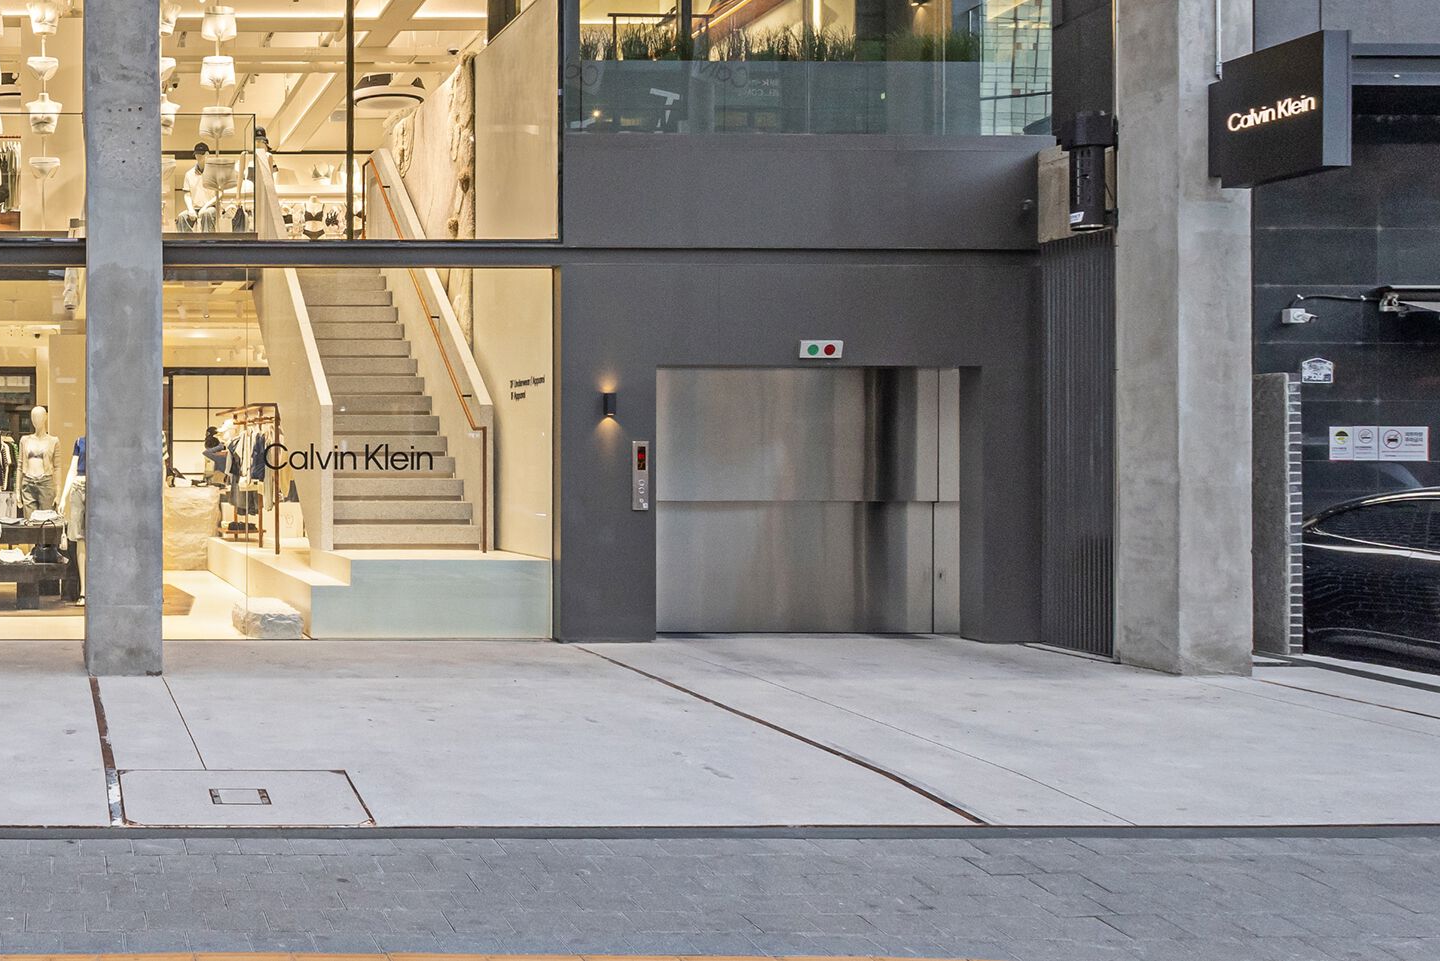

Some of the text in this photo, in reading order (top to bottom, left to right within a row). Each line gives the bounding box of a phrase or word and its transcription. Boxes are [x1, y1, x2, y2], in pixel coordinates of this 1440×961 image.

[1227, 95, 1316, 131] Calvin Klein
[264, 443, 433, 470] Calvin Klein
